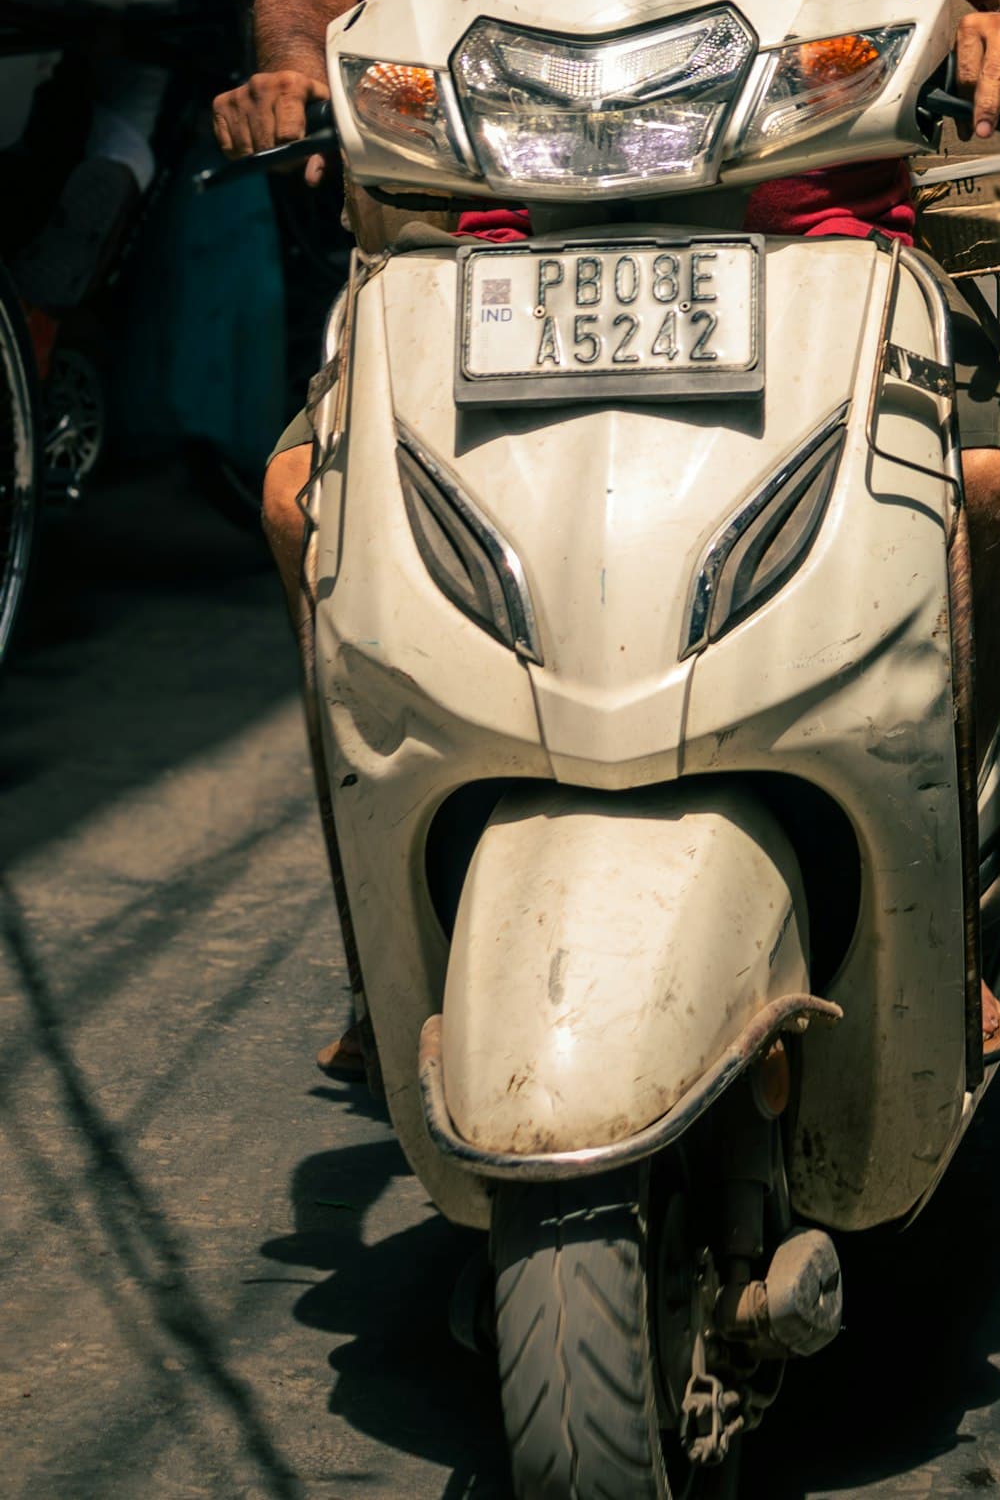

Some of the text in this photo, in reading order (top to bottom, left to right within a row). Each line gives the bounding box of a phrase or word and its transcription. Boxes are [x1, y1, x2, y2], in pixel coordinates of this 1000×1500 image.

[538, 252, 718, 307] PB08E
[481, 307, 512, 323] IND
[536, 311, 718, 364] A5242
